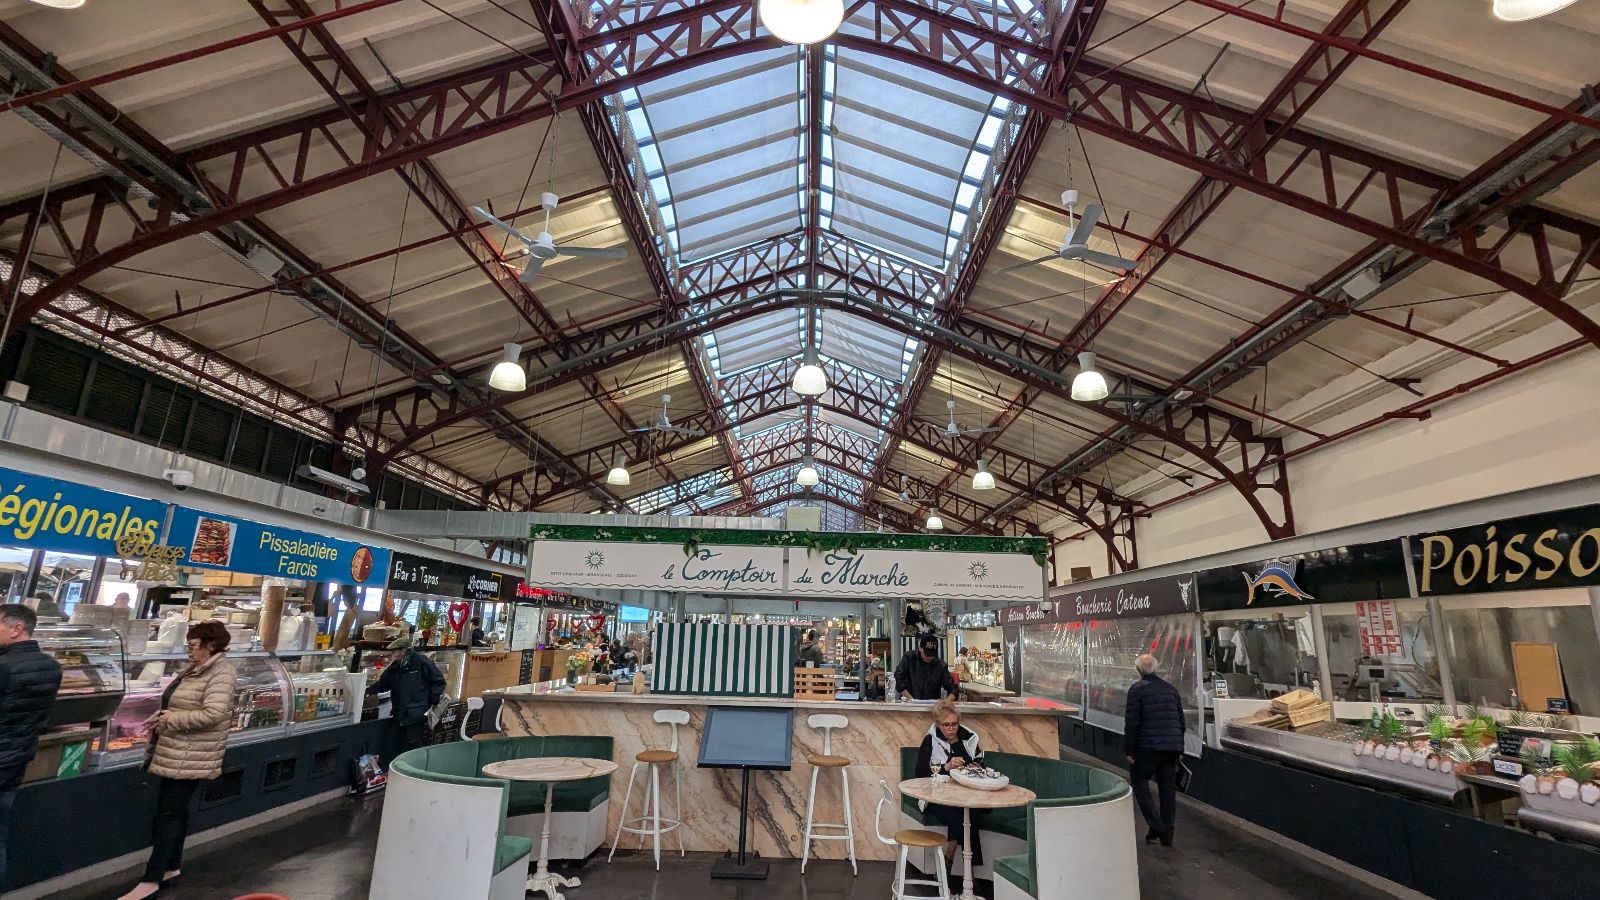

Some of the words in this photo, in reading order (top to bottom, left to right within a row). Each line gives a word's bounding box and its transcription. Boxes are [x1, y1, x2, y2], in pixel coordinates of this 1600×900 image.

[0, 484, 159, 544] égionales
[259, 531, 338, 561] Pissaladière
[278, 555, 318, 577] Farcis
[393, 560, 409, 581] Bar
[411, 567, 417, 582] à
[420, 566, 439, 590] Tapas
[661, 564, 675, 580] le
[682, 548, 778, 591] Comptoir
[793, 568, 813, 584] du
[821, 553, 910, 587] Marché
[1075, 593, 1112, 615] Boucherie
[1116, 588, 1151, 615] Catena
